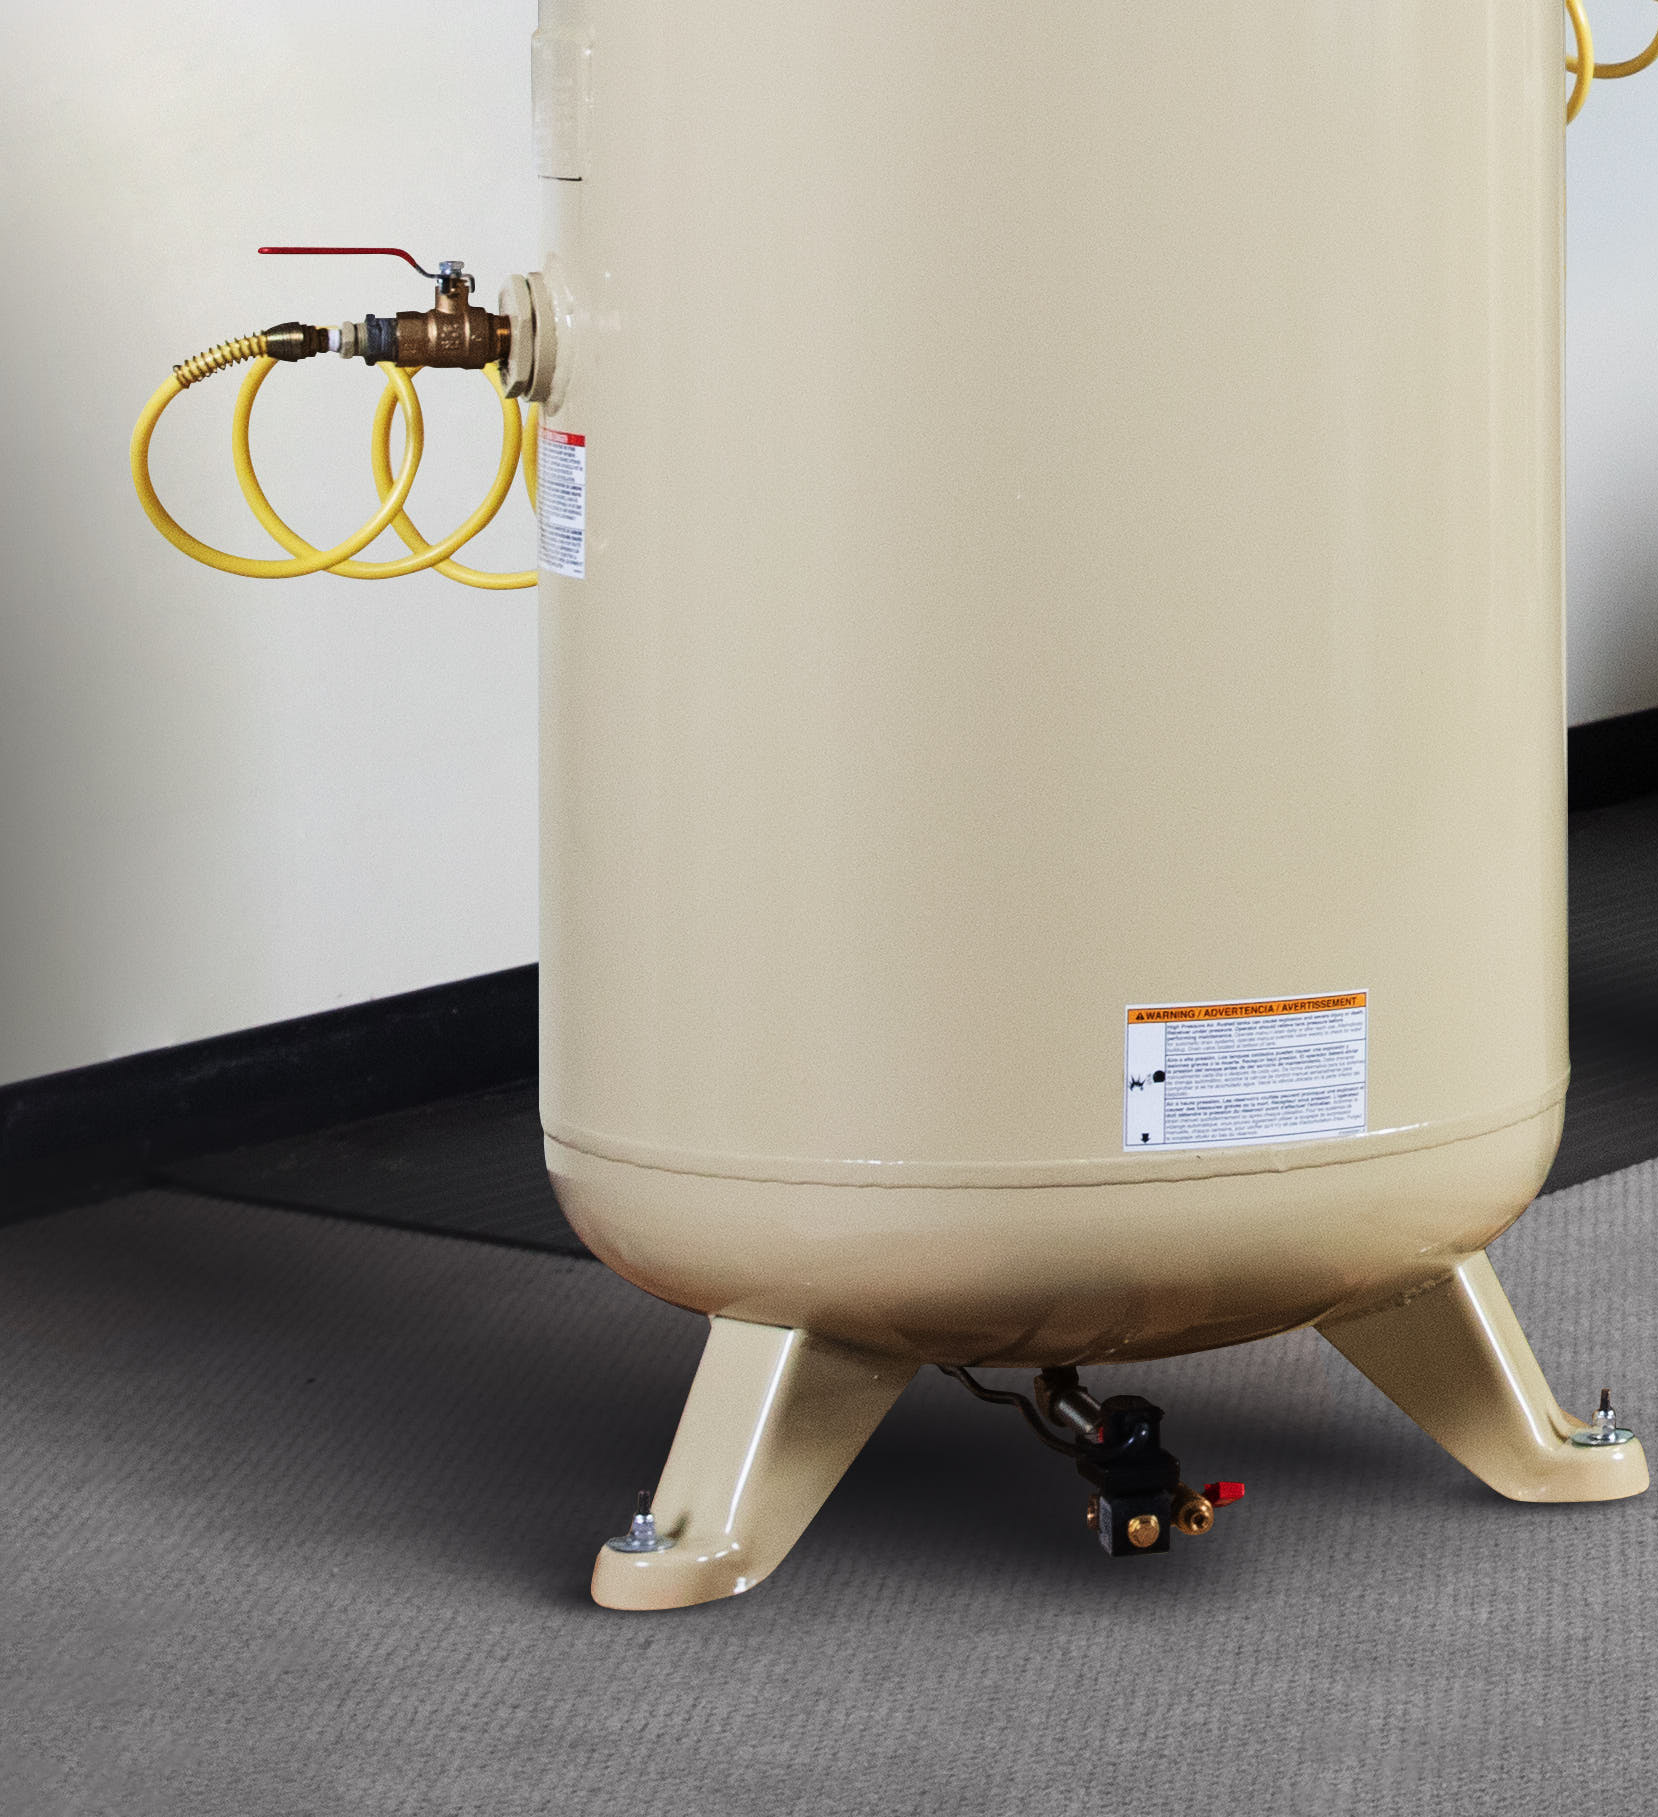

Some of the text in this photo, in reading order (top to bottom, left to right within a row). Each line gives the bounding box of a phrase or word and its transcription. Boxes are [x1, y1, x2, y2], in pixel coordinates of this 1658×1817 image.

[1145, 1008, 1195, 1021] WARNING
[1204, 1004, 1275, 1017] ADVERTENCIA
[1282, 996, 1357, 1012] AVERTISSEMENT
